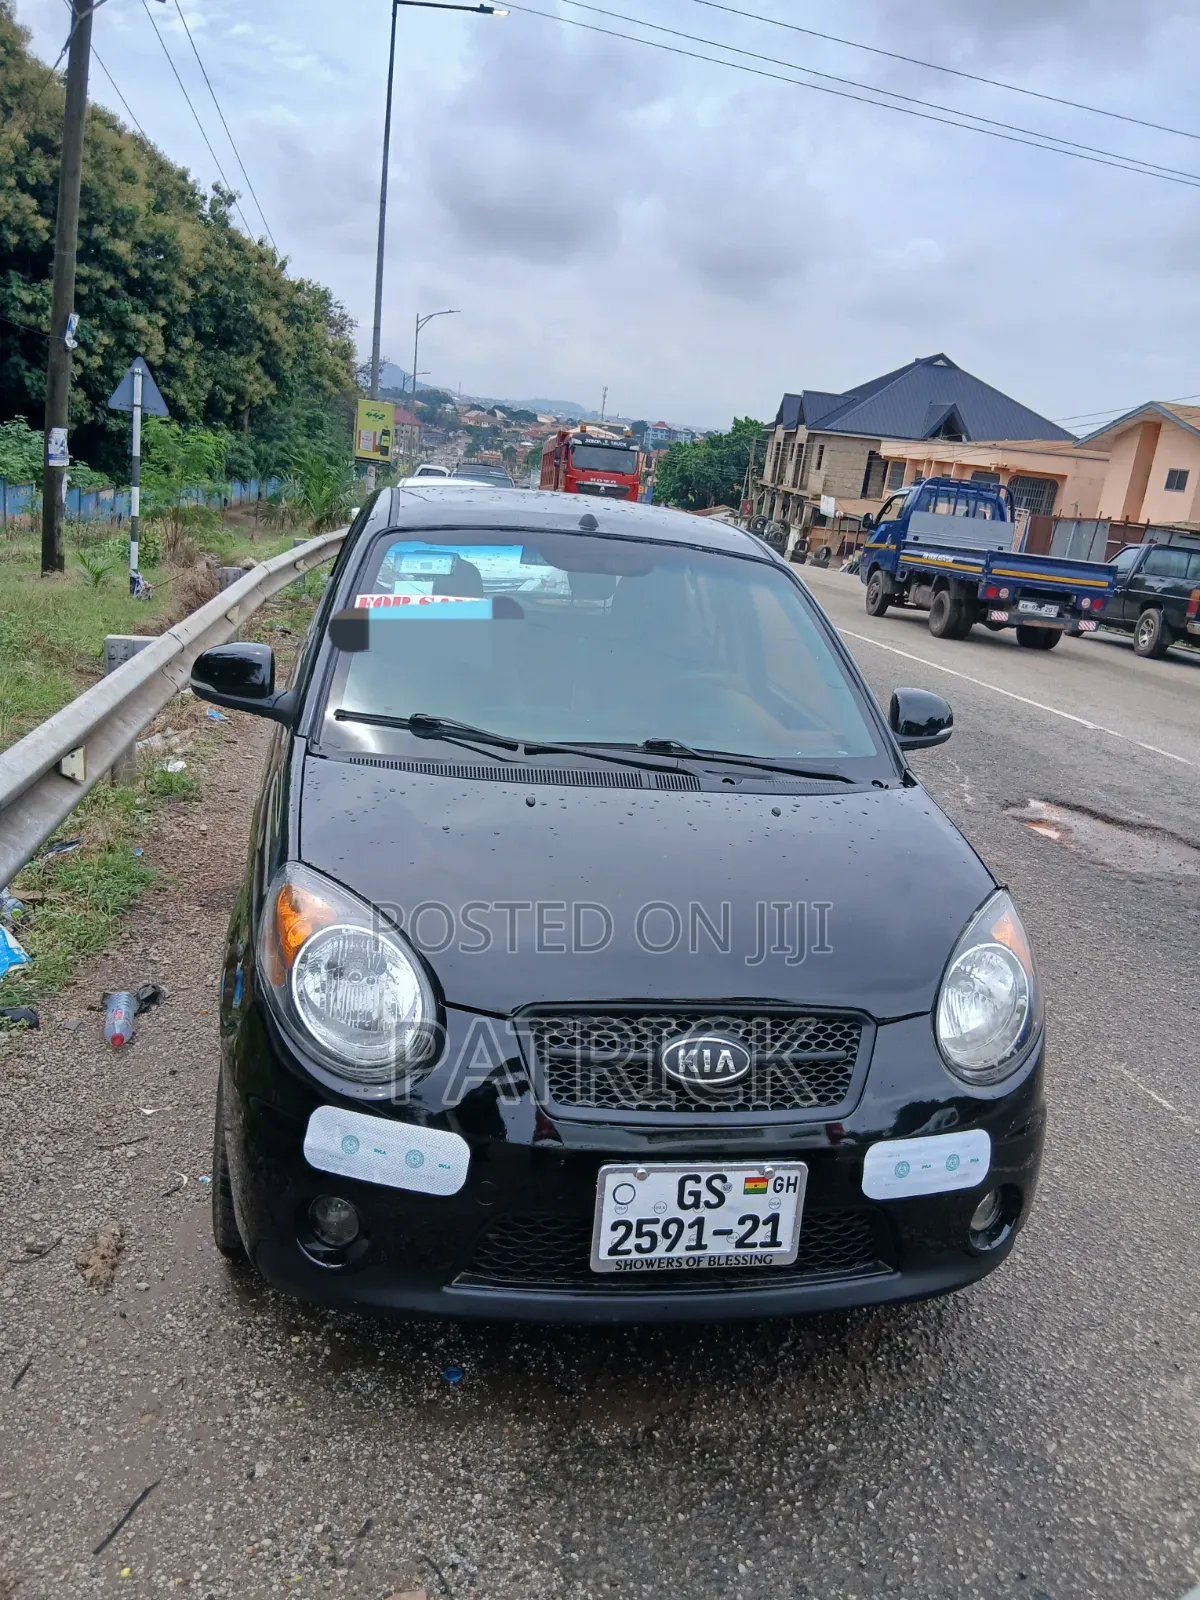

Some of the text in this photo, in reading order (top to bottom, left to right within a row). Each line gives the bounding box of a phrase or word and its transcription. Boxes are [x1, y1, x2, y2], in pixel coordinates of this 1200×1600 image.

[678, 1049, 736, 1073] KIA
[677, 1173, 728, 1211] GS
[772, 1176, 798, 1193] GH
[607, 1213, 782, 1256] 2591-21
[615, 1254, 773, 1270] SHOWERS OF BLESSING
